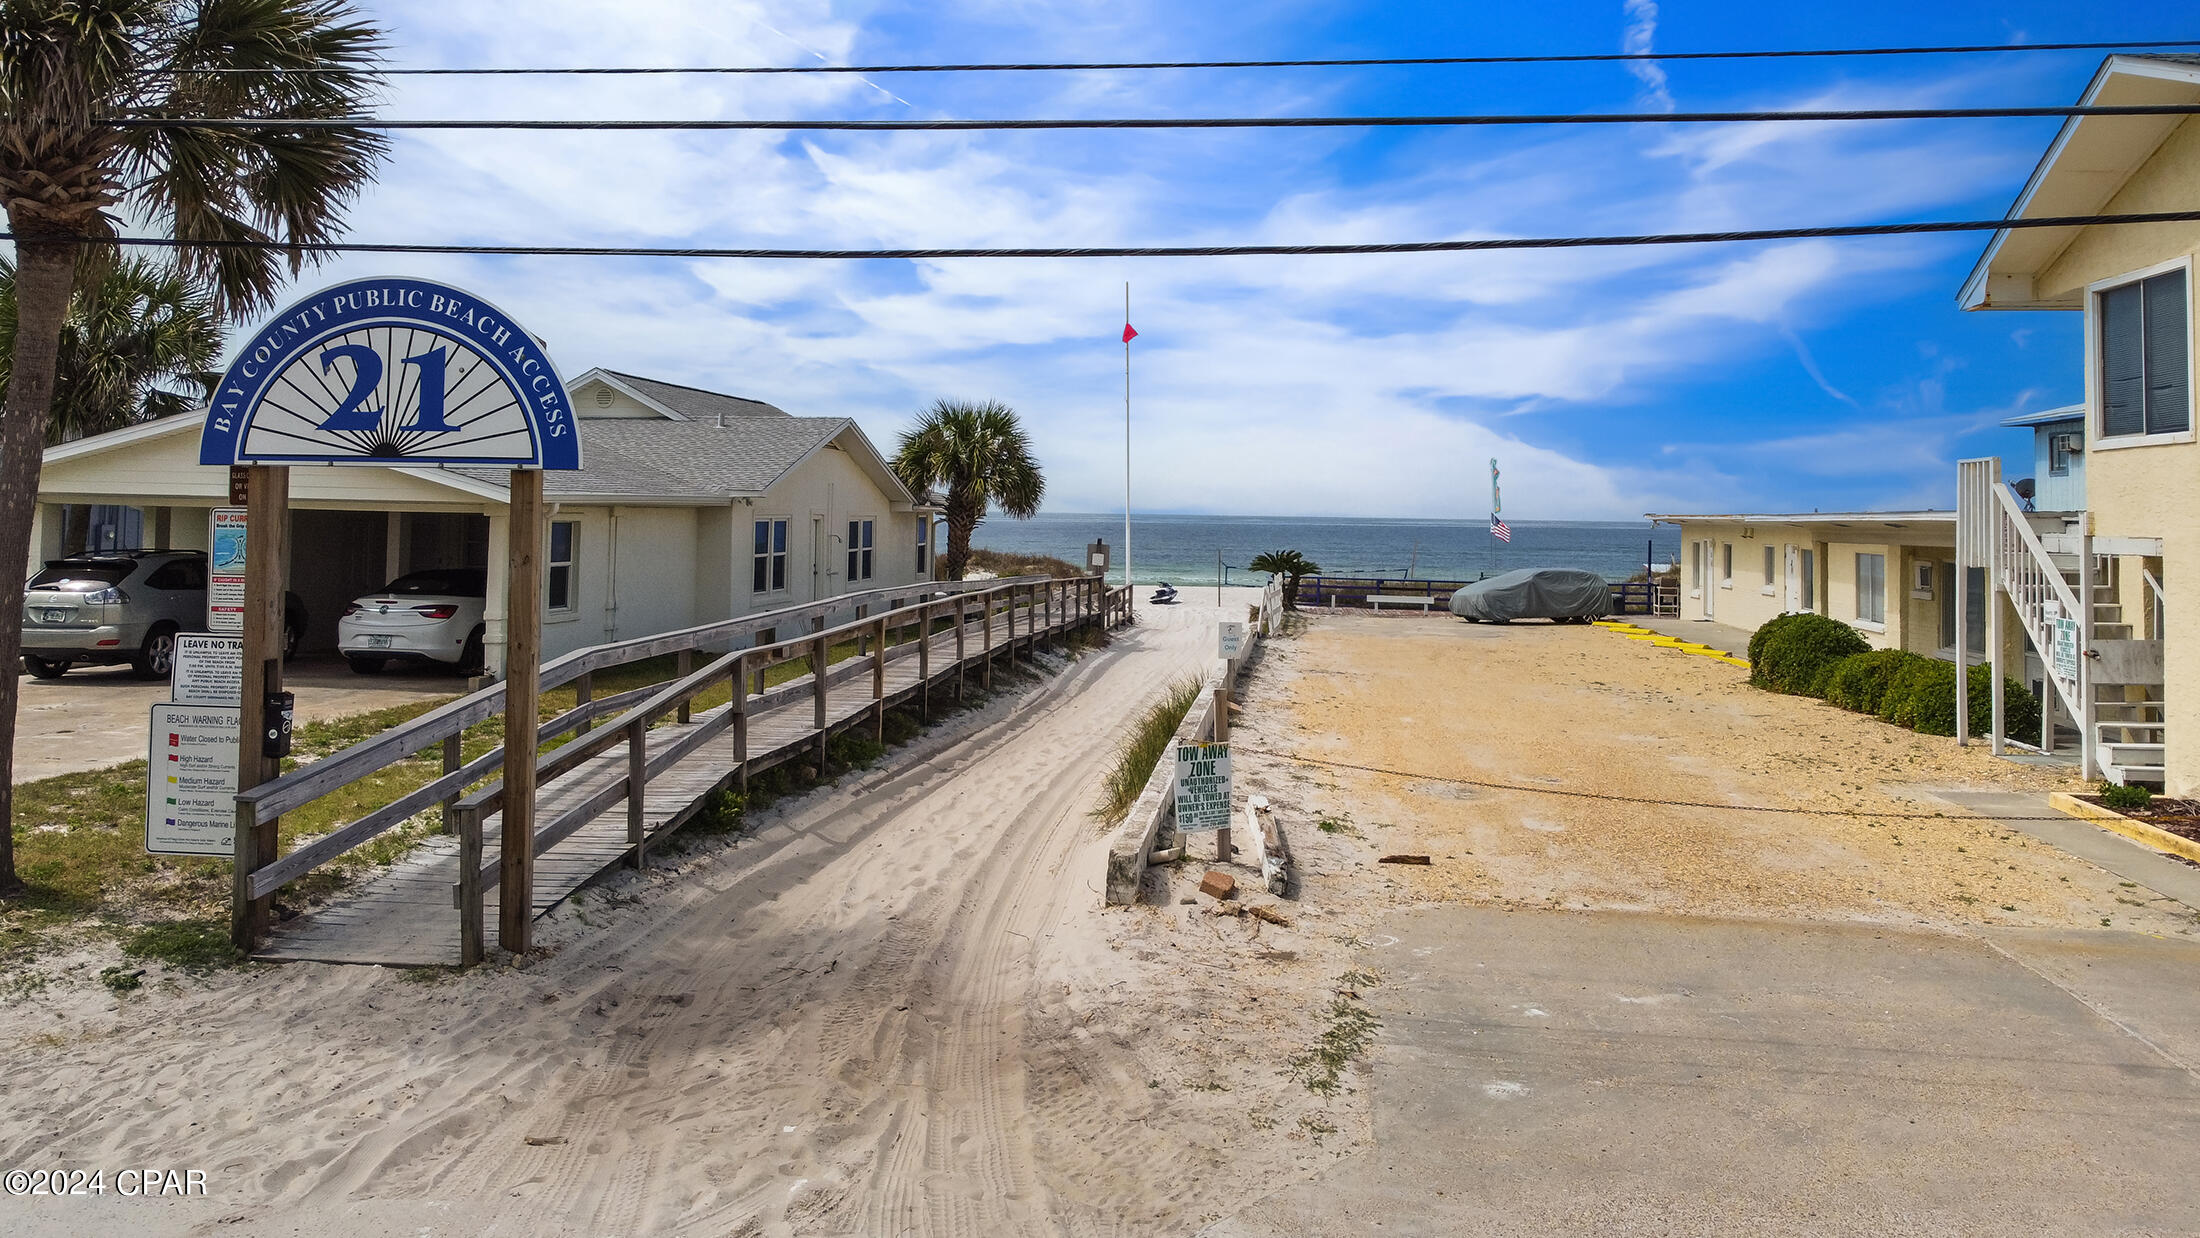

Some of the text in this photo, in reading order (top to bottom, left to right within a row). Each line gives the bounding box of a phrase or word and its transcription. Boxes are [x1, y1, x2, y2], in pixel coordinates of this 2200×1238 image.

[214, 288, 567, 438] BAY COUNTY PUBLIC BEACH ACCESS
[314, 344, 462, 432] 21
[2060, 630, 2071, 641] ZONE
[184, 640, 208, 648] LEAVE
[227, 641, 243, 649] TRA
[166, 714, 240, 726] BEACH WARNING FLA
[1177, 744, 1229, 762] TOW AWAY
[1190, 761, 1216, 777] ZONE
[1180, 776, 1226, 787] UNAUTHORIZED
[1190, 784, 1217, 794] VEHICLES
[1178, 791, 1230, 803] WILL BE TOWED AT
[1206, 800, 1230, 810] EXPENSE
[177, 818, 208, 828] Dangerous
